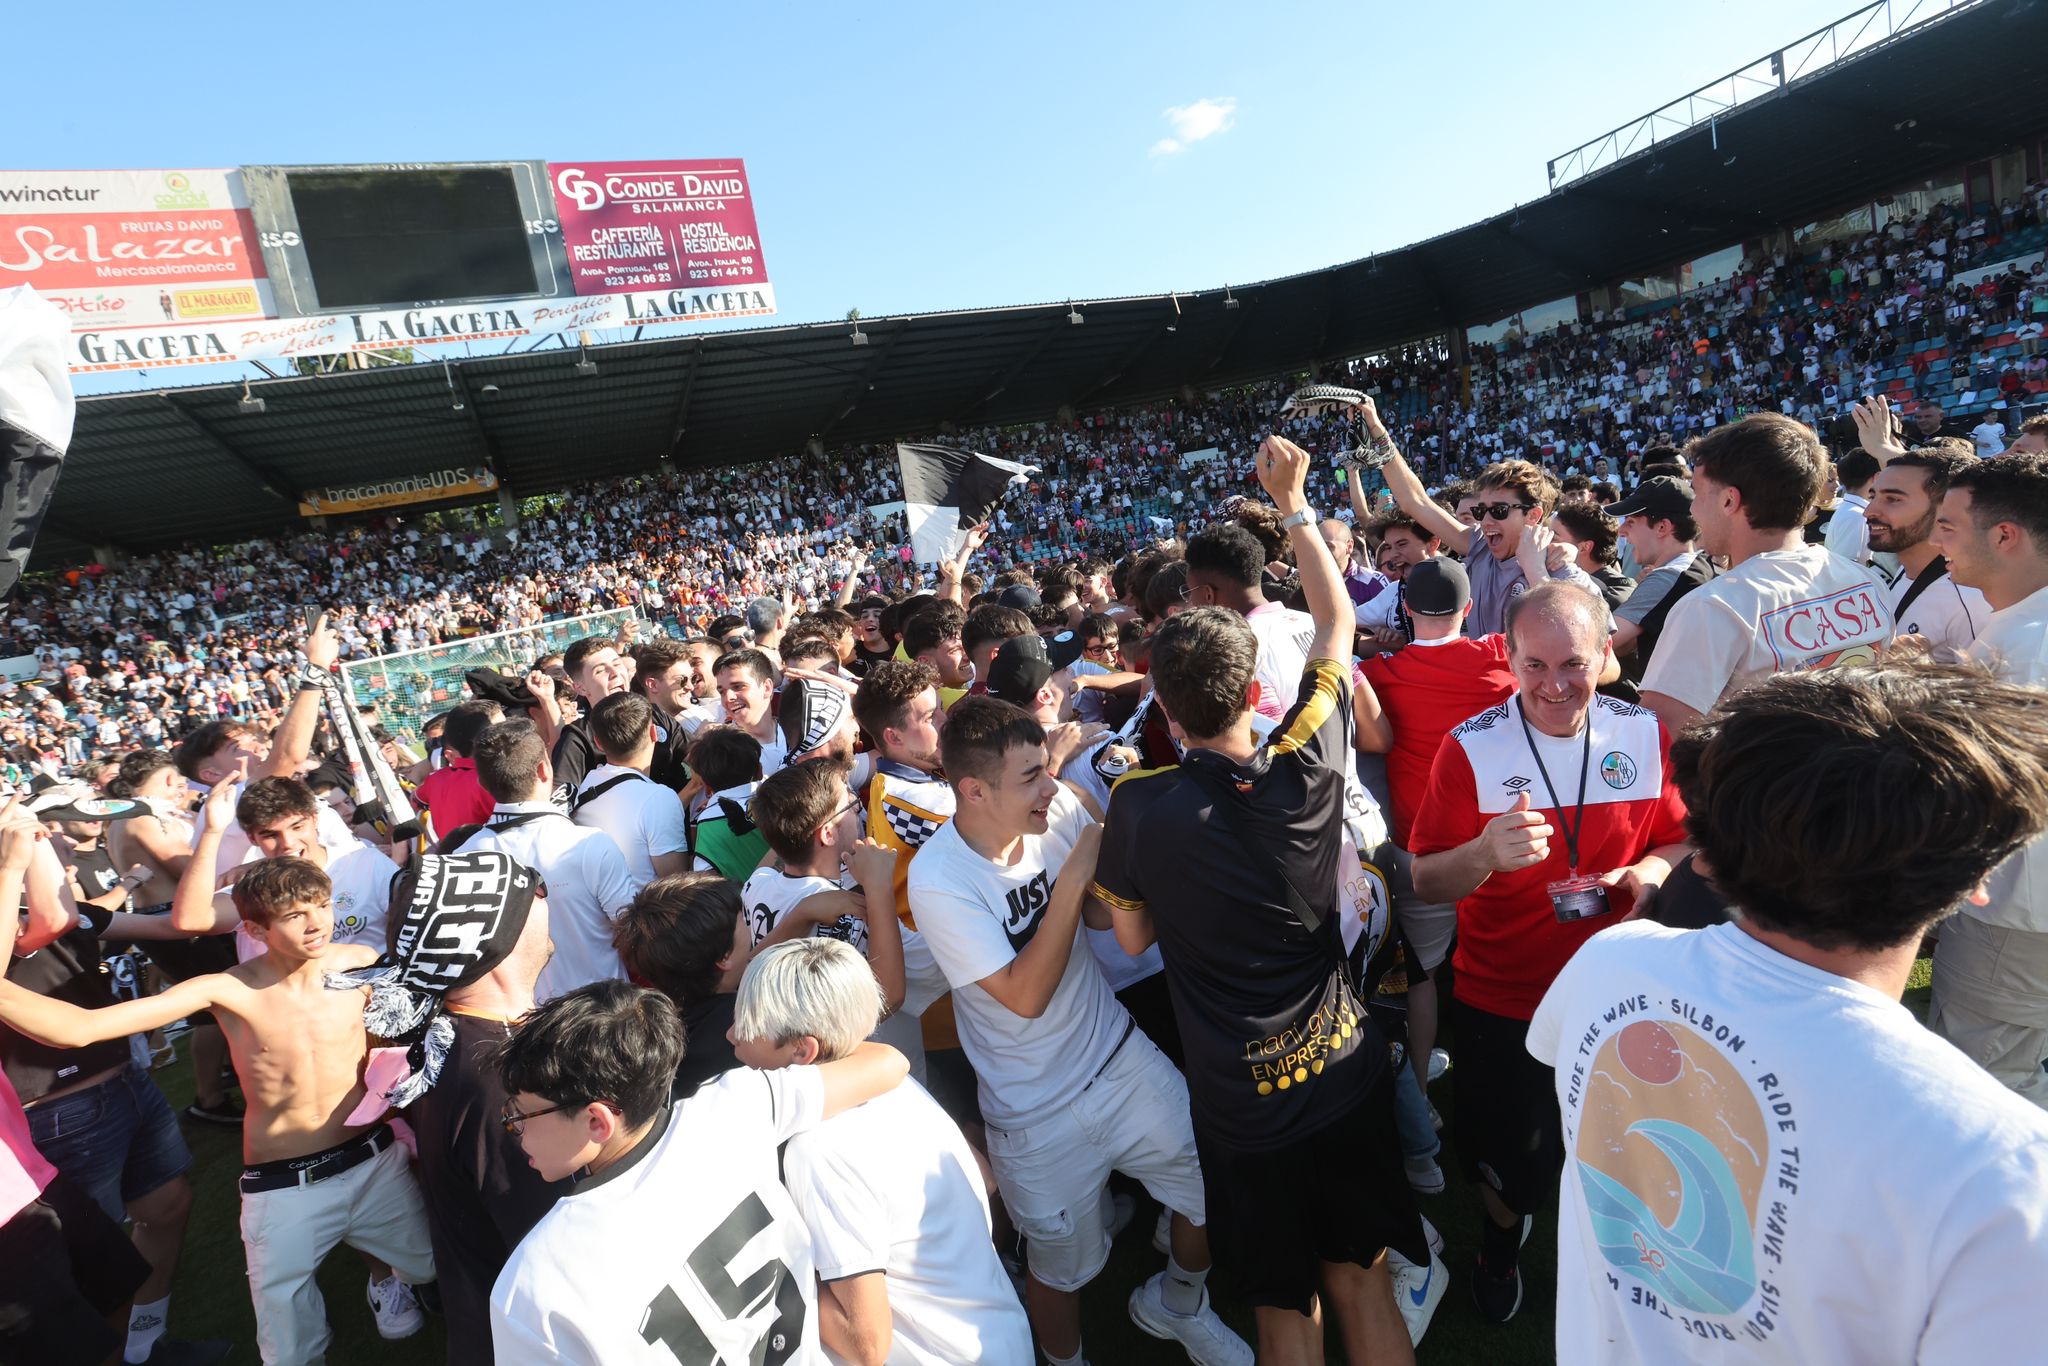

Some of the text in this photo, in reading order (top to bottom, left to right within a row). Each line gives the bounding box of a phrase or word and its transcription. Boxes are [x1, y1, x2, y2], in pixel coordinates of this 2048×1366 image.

[606, 175, 743, 198] CONDE DAVID
[632, 200, 726, 214] SALAMANCA
[121, 220, 223, 233] FRUTAS DAVID
[591, 222, 663, 244] CAFETERÍA
[680, 222, 728, 239] HOSTAL
[0, 224, 243, 271] Salazar
[573, 241, 666, 261] RESTAURANTE
[683, 236, 756, 254] RESIDENCIA
[96, 262, 236, 278] Mercasalamanca
[604, 273, 672, 286] 923 24 06 23
[653, 262, 669, 271] 163
[689, 266, 753, 279] 923 61 44 79
[624, 290, 768, 319] LA GACETA
[350, 310, 523, 343] LA GACETA
[78, 333, 229, 363] GACETA
[1785, 592, 1881, 651] CASA
[1005, 868, 1052, 927] JUST
[1603, 994, 1648, 1023] WAVE
[1579, 1022, 1601, 1056] THE
[1671, 998, 1746, 1053] SILBON
[1246, 1021, 1303, 1060] nani
[1568, 1062, 1584, 1108] RIDE
[1757, 1072, 1797, 1132] RIDE
[288, 1158, 319, 1170] Calvin
[1778, 1147, 1800, 1195] THE
[1763, 1201, 1787, 1264] WAVE
[638, 1191, 806, 1366] 15
[1631, 1286, 1674, 1320] THE
